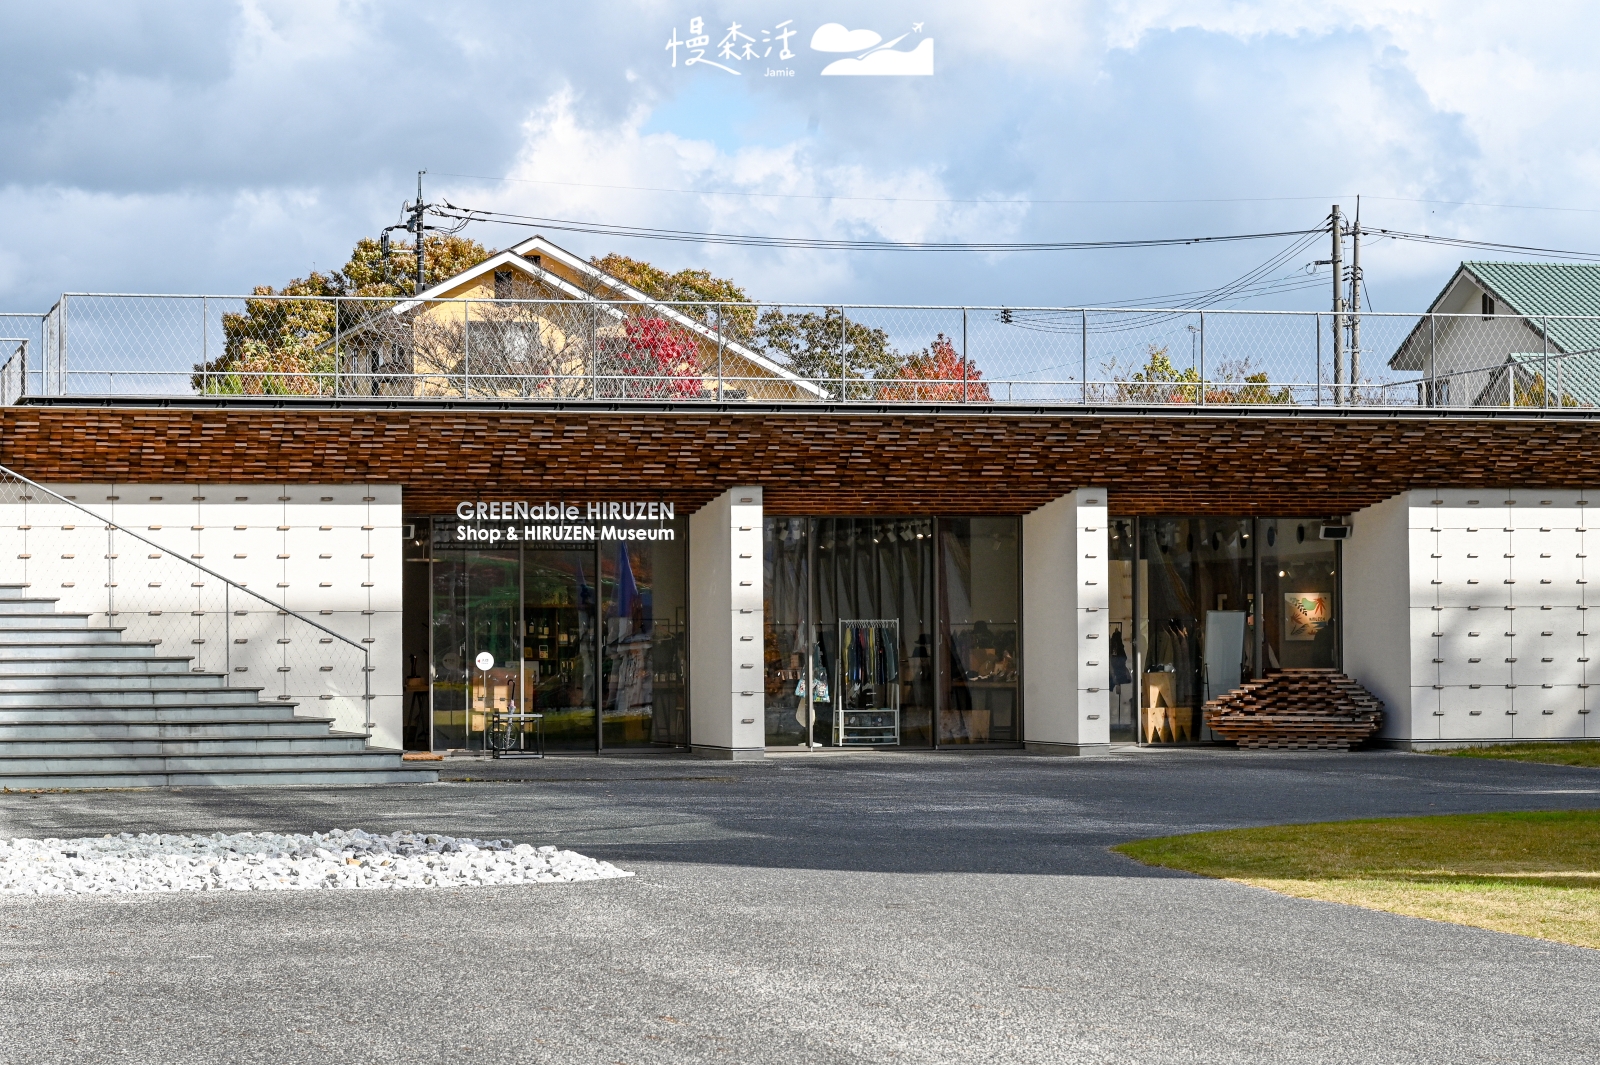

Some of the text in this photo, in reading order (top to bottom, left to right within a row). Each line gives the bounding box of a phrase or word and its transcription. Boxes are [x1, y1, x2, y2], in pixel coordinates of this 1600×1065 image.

[456, 501, 675, 521] GREENable HIRUZEN
[456, 525, 675, 544] Shop & HIRUZEN Museum
